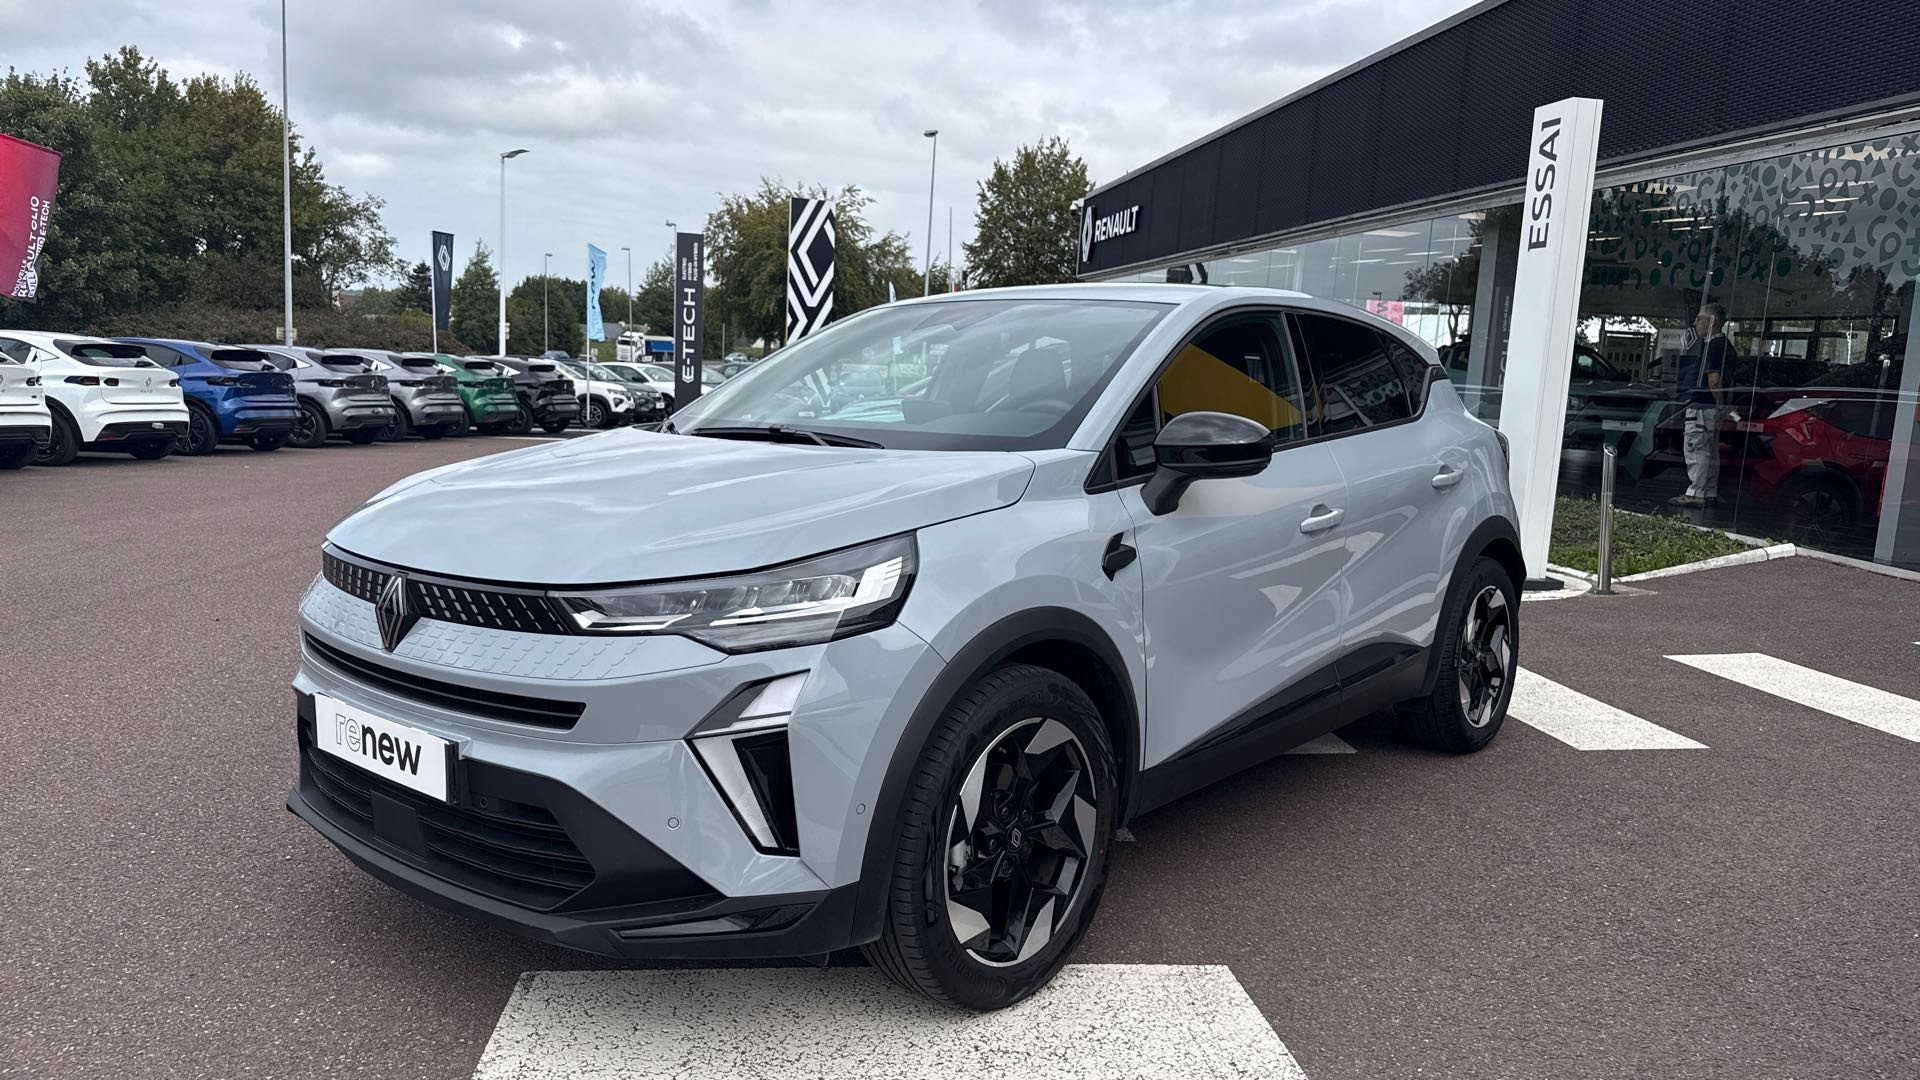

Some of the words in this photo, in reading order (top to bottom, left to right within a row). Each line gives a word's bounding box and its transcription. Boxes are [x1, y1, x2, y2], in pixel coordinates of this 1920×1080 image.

[1528, 117, 1561, 252] ESSAI
[40, 200, 50, 236] E-TECH
[1094, 205, 1139, 243] RENAULT
[682, 288, 696, 383] E-TECH
[335, 713, 422, 776] renew
